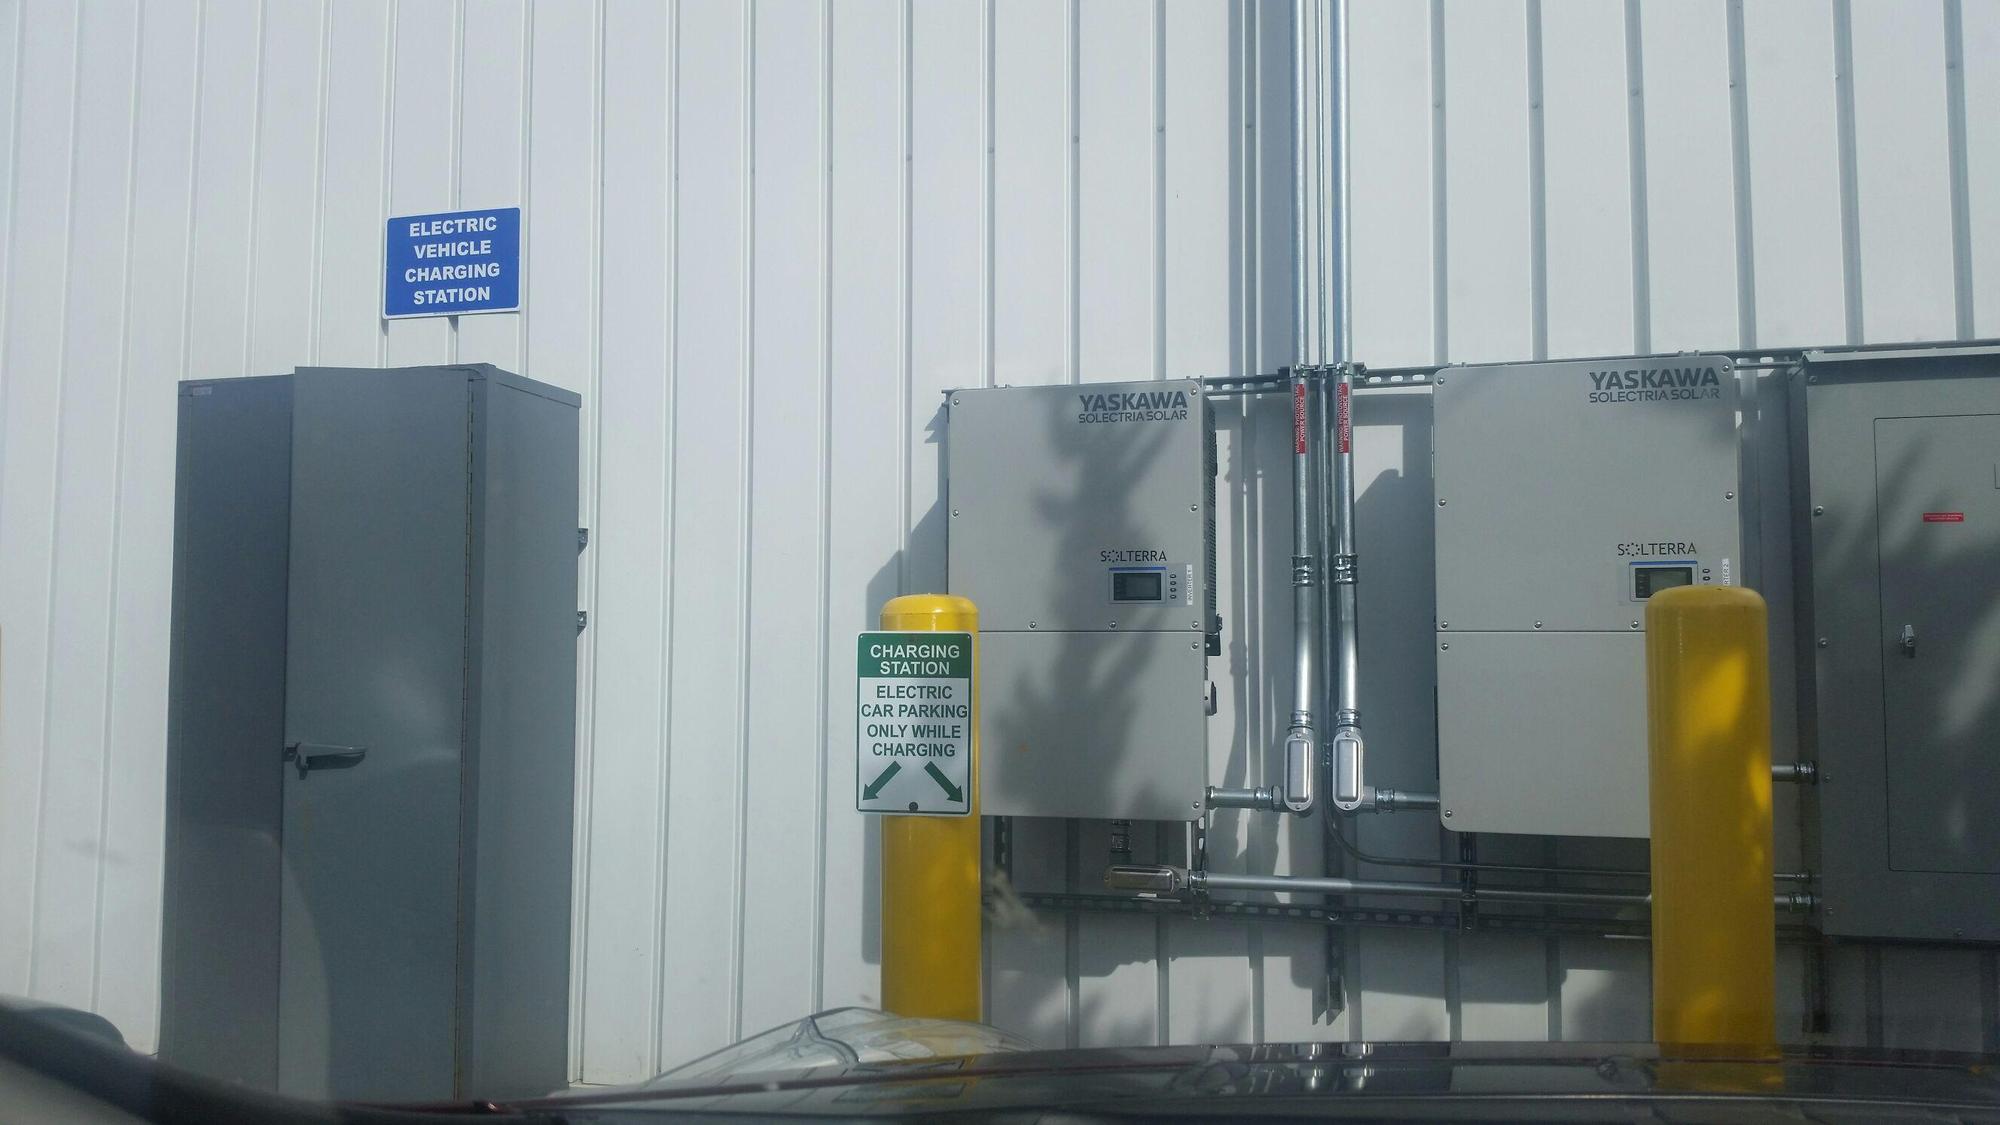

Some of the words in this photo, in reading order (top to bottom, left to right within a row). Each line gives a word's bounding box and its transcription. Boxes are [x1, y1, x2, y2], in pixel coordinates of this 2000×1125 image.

[410, 217, 497, 237] ELECTRIC
[414, 240, 491, 259] VEHICLE
[405, 263, 500, 283] CHARGING
[414, 287, 490, 305] STATION
[1589, 367, 1720, 390] YASKAWA
[1079, 391, 1188, 412] YASKAWA
[1589, 390, 1669, 403] SOLECTRIA
[1671, 388, 1720, 400] SOLAR
[1078, 412, 1144, 424] SOLECTRIA
[1146, 410, 1188, 421] SOLAR
[1100, 549, 1167, 562] SOLTERRA
[1617, 542, 1697, 556] SOLTERRA
[870, 645, 960, 659] CHARGING
[880, 661, 950, 675] STATION
[876, 685, 953, 699] ELECTRIC
[861, 704, 894, 718] CAR
[898, 705, 968, 719] PARKING
[867, 724, 908, 738] ONLY
[912, 725, 961, 739] WHILE
[872, 743, 956, 757] CHARGING
